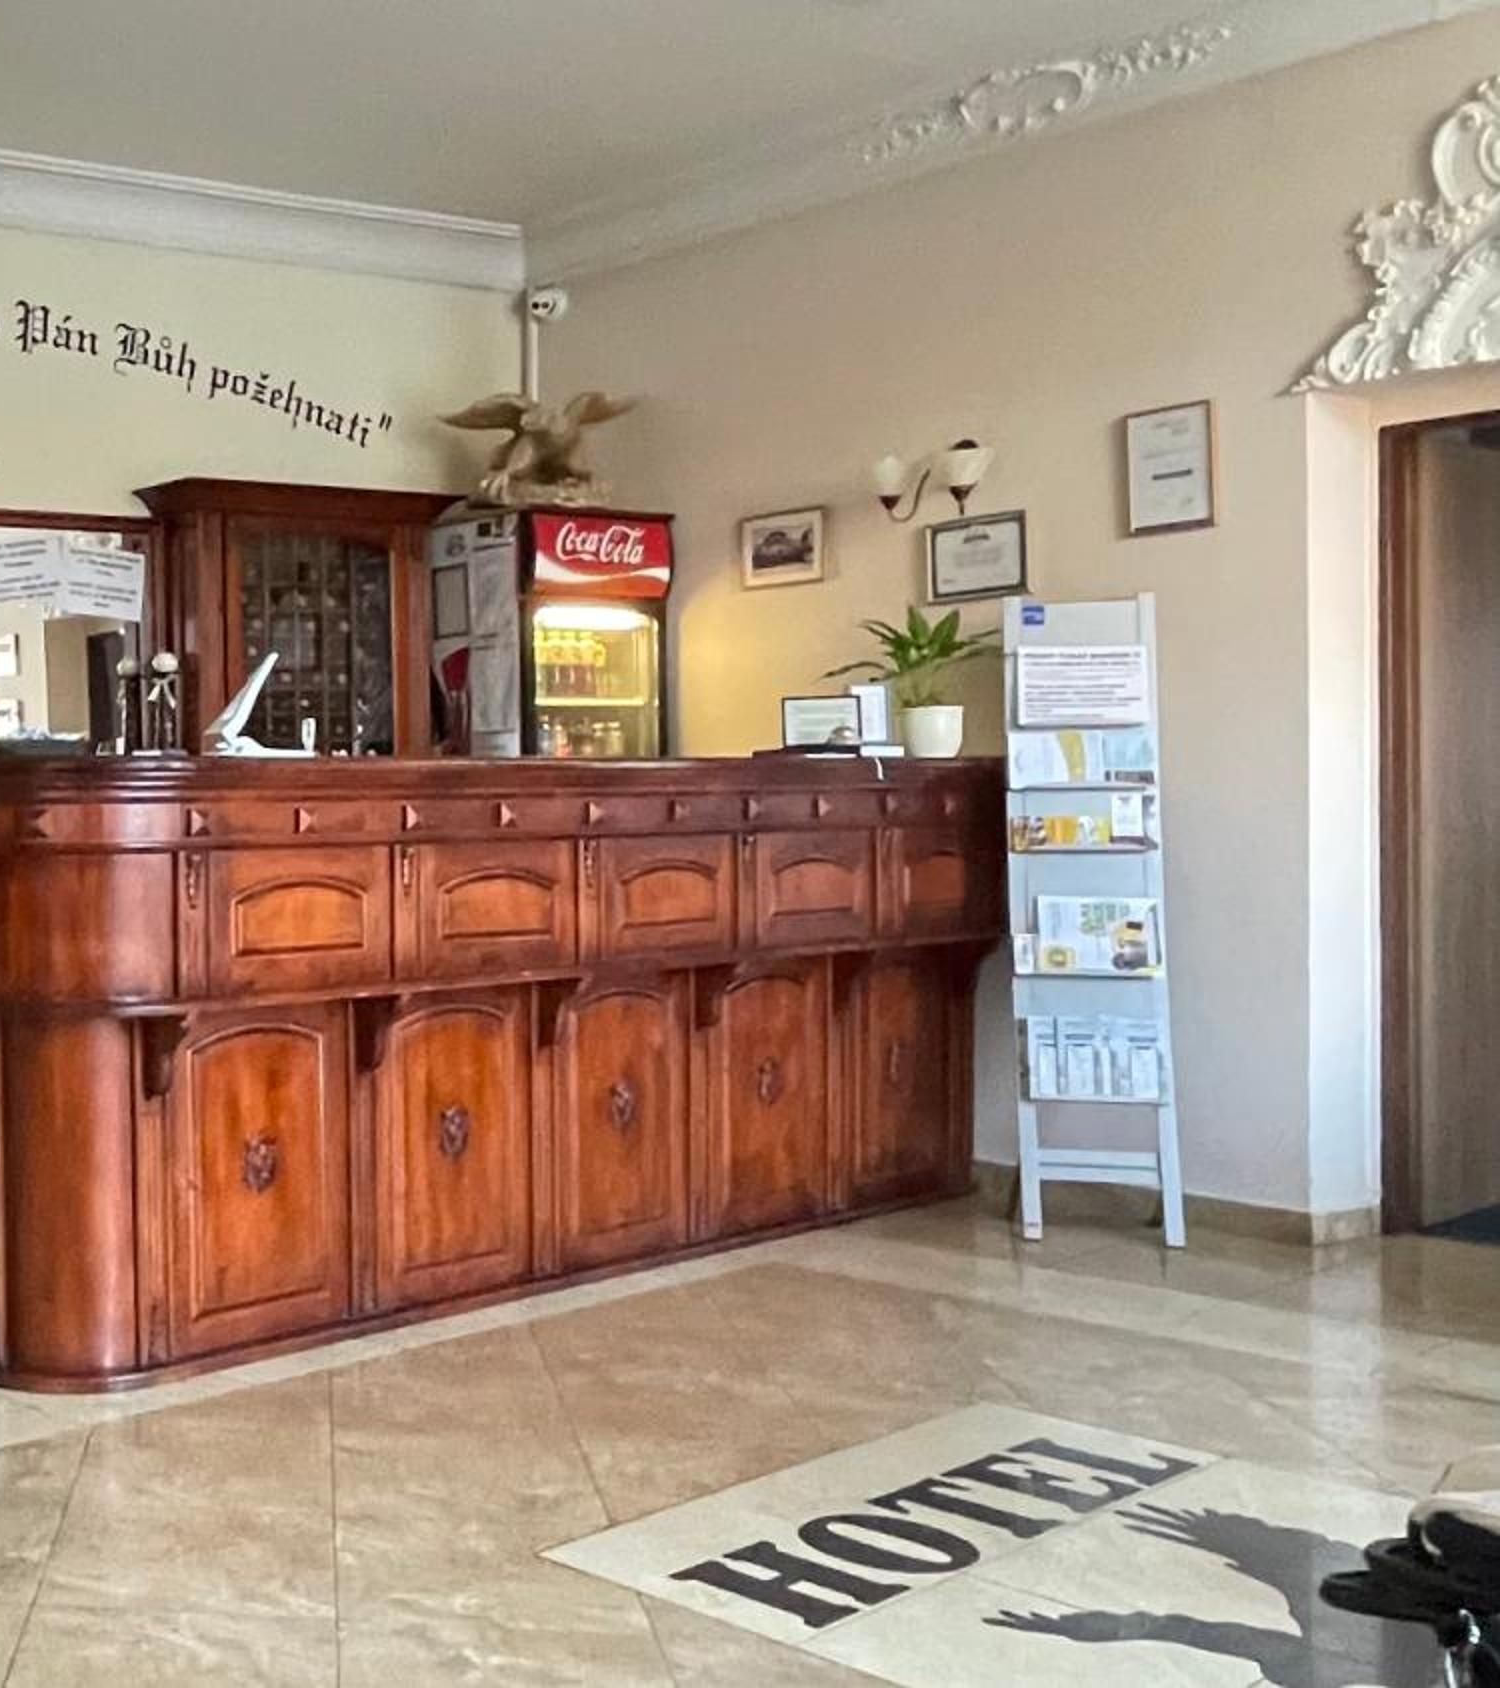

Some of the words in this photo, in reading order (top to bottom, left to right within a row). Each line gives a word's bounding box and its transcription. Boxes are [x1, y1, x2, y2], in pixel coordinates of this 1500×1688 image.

[14, 299, 99, 356] Pán
[113, 322, 197, 393] Bůh
[555, 520, 645, 565] Coca-Cola
[668, 1436, 1201, 1628] HOTEL
